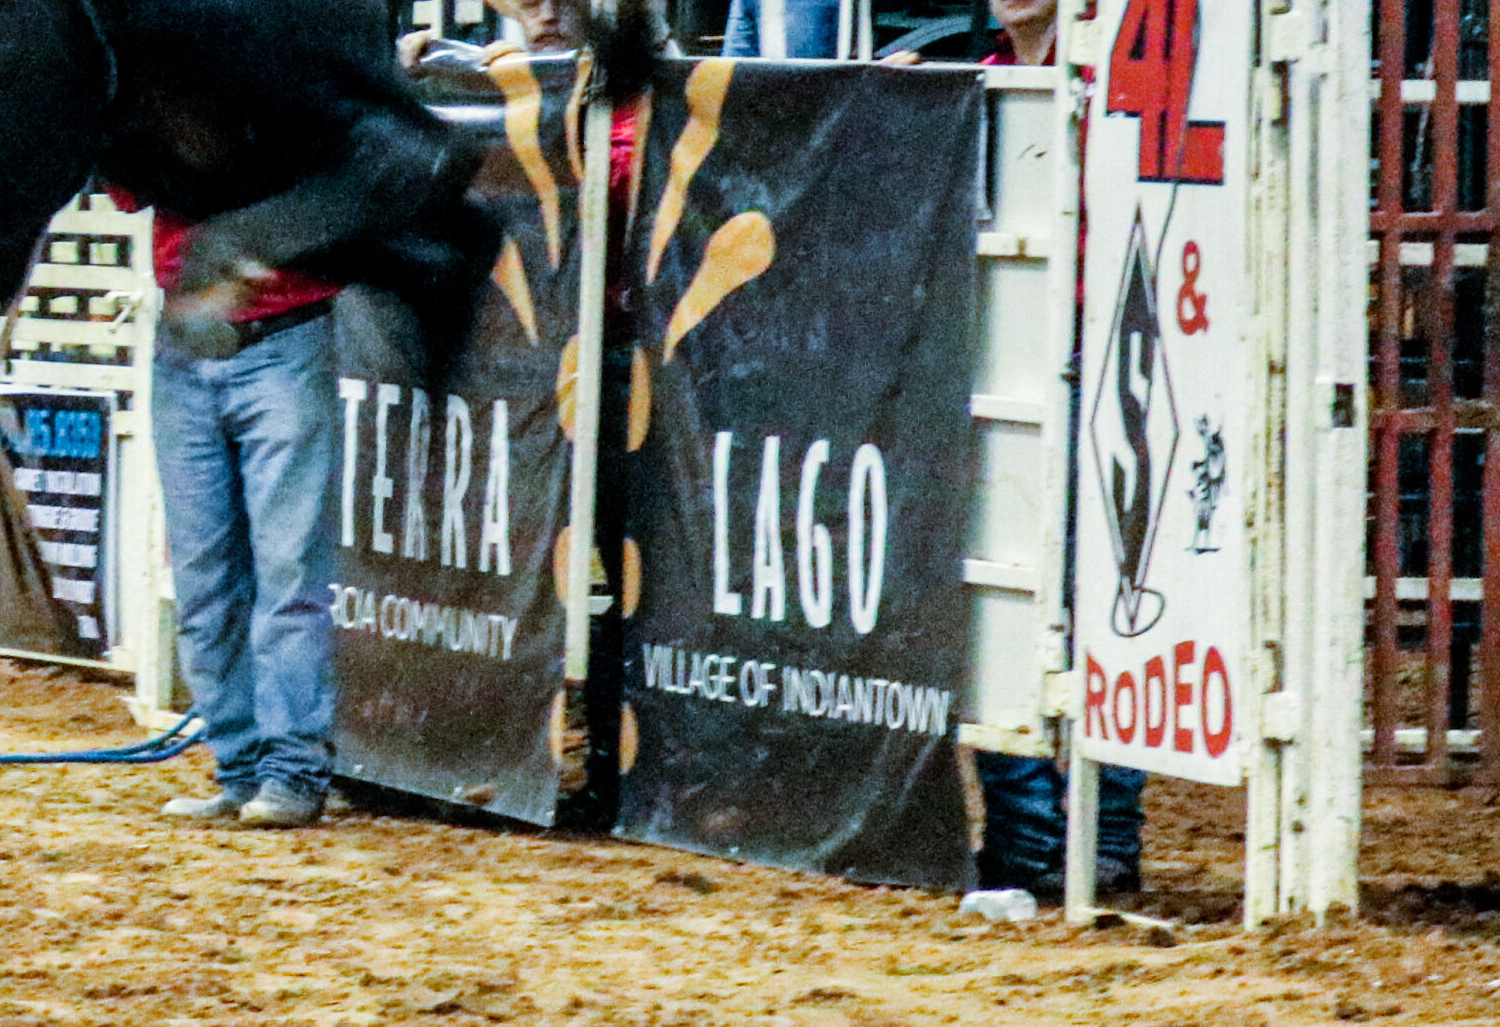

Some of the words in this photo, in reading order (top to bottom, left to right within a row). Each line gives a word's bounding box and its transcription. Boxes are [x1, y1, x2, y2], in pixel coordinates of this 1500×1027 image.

[1176, 240, 1210, 336] &
[338, 377, 512, 577] TERRA
[712, 431, 888, 635] LAGO
[379, 593, 518, 661] COMMUNITY
[643, 642, 737, 703] VILLAGE
[739, 659, 777, 708] OF
[782, 665, 950, 736] INDIANTOWN
[1083, 639, 1233, 759] RODEO
